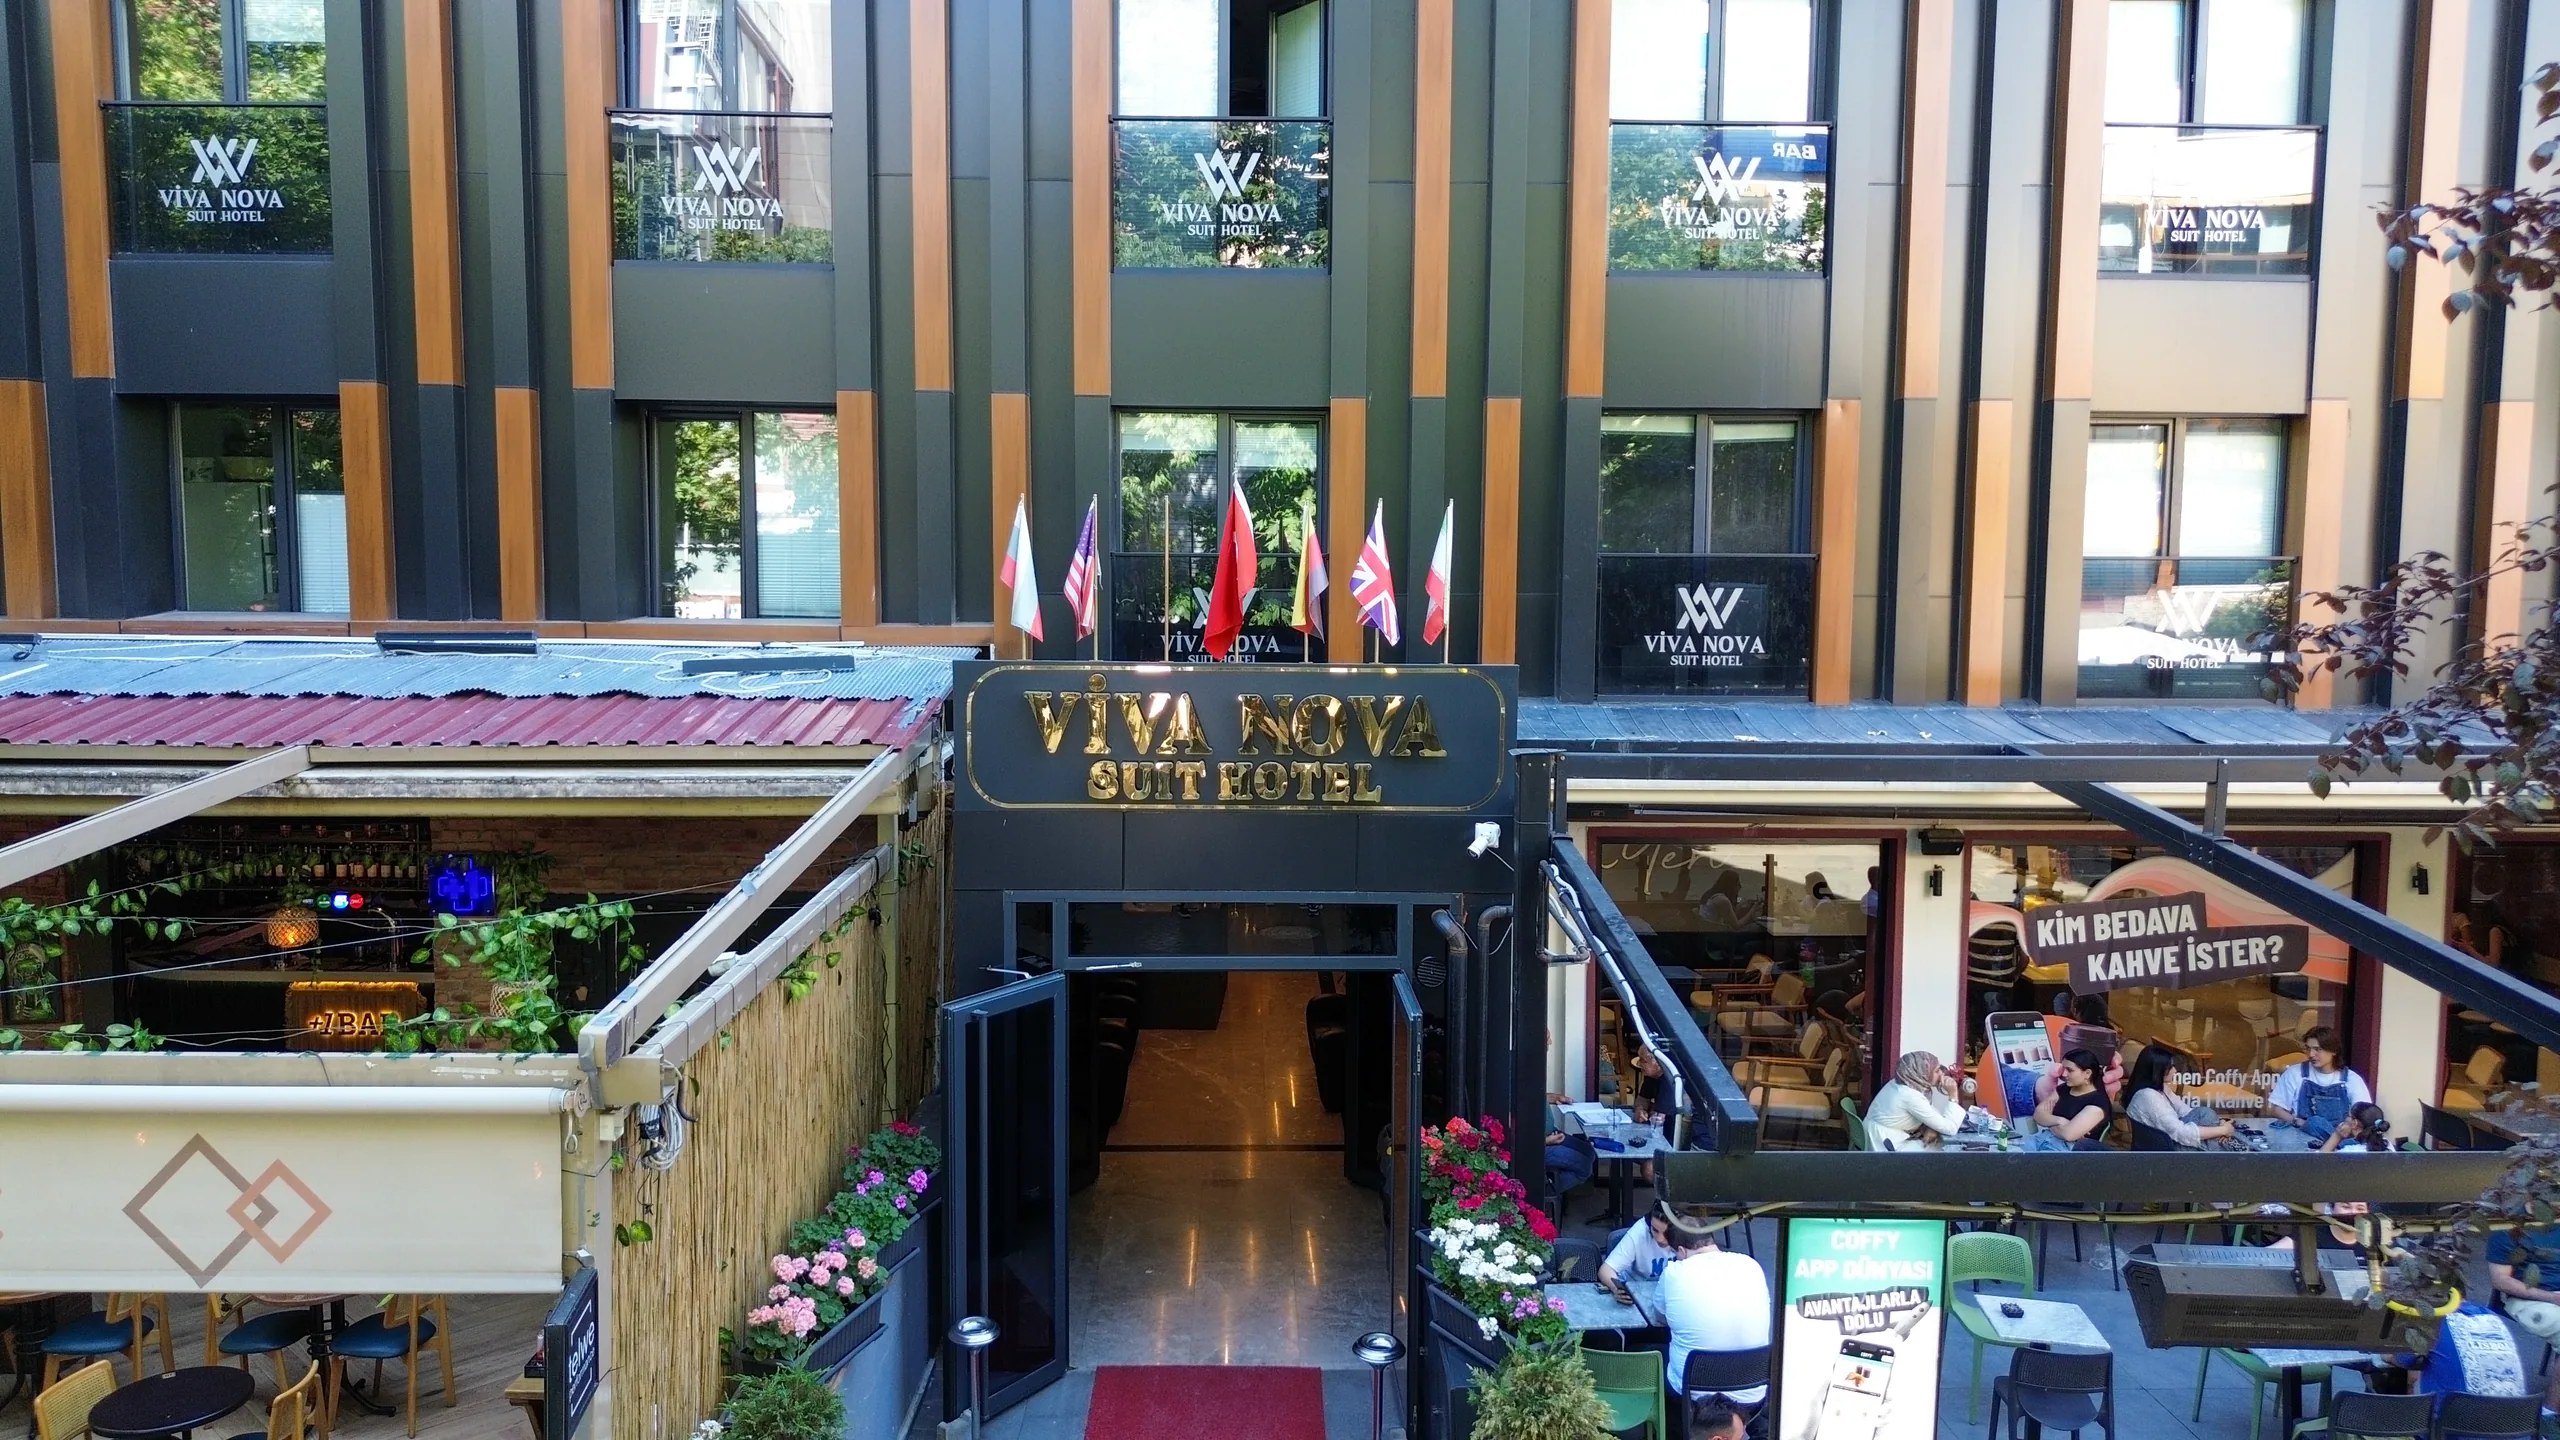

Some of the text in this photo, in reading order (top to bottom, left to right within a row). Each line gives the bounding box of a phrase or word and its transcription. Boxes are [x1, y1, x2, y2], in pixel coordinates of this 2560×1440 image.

[158, 184, 284, 209] VİVA NOVA
[186, 210, 265, 222] SUIT HOTEL
[722, 197, 783, 217] NOVA
[1161, 198, 1282, 223] VİVA NOVA
[1720, 207, 1780, 227] NOVA
[688, 218, 764, 230] SUIT HOTEL
[2205, 209, 2267, 229] NOVA
[1187, 224, 1262, 236] SUIT HOTEL
[1685, 228, 1712, 239] SUIT
[2170, 230, 2246, 242] SUIT HOTEL
[1234, 634, 1281, 653] OVA
[1643, 630, 1766, 653] VİVA NOVA
[1670, 655, 1743, 667] SUIT HOTEL
[2147, 657, 2222, 669] SUIT HOTEL
[1023, 673, 1448, 757] VİVA NOVA
[1088, 760, 1383, 803] SUIT HOTEL
[2036, 904, 2198, 948] KİM BEDAVA
[2087, 935, 2284, 982] KAHVE İSTER?
[2205, 1068, 2247, 1088] Coffy
[2251, 1068, 2281, 1090] App
[1831, 1230, 1901, 1250] COFFY
[1794, 1254, 1934, 1281] APP DÜNYASI
[1803, 1289, 1922, 1318] AVANTAJLARLA
[1843, 1311, 1886, 1331] DOLU
[568, 1321, 596, 1384] telwe
